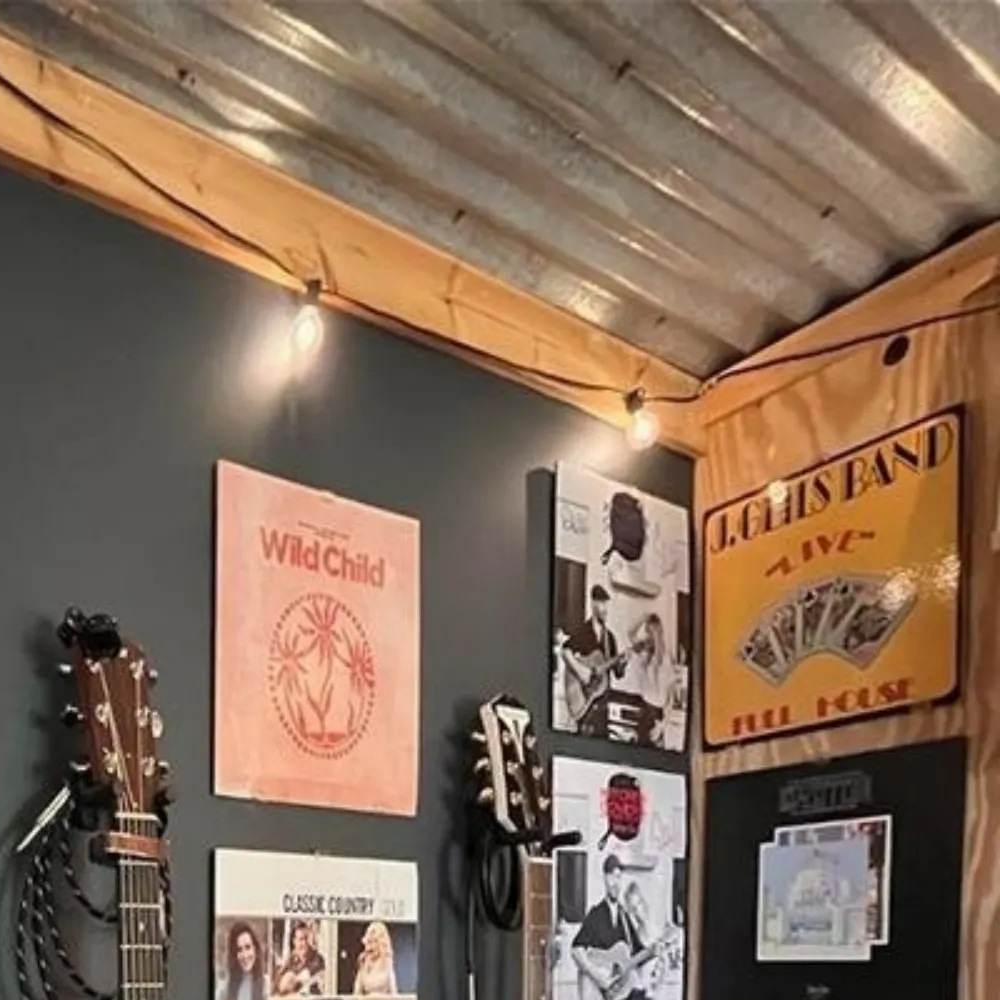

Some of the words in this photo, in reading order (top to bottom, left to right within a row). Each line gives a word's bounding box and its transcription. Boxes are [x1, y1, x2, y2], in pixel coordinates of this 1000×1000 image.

[843, 420, 955, 501] BAND
[260, 526, 320, 572] Wild
[322, 545, 386, 589] Child
[281, 892, 325, 914] CLASSIC
[327, 895, 375, 916] COUNTRY
